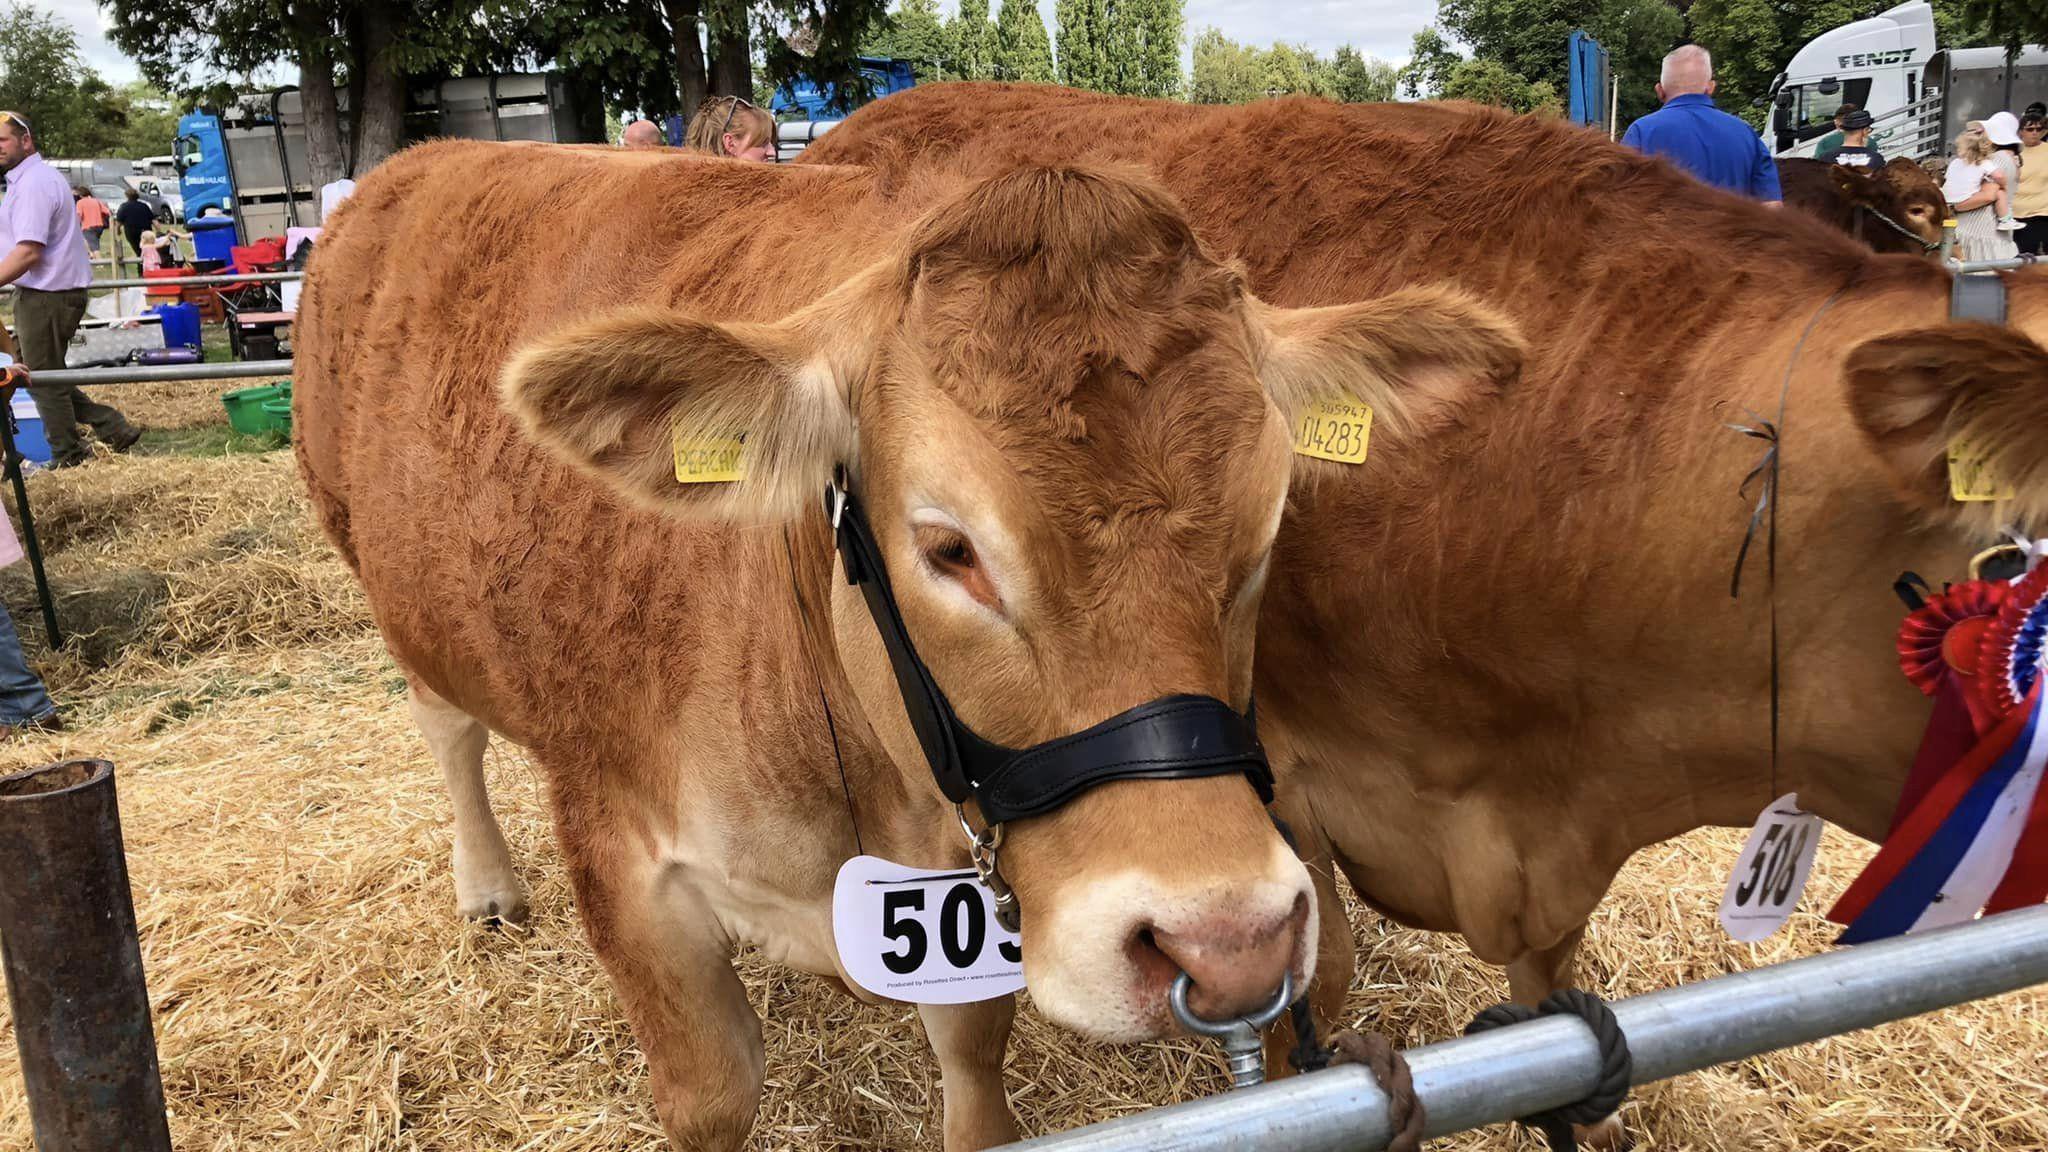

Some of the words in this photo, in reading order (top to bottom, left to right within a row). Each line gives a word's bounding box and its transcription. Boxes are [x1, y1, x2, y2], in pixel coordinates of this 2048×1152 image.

[1838, 47, 1917, 69] FENDT
[1735, 823, 1810, 907] 508
[887, 980, 914, 989] Produced
